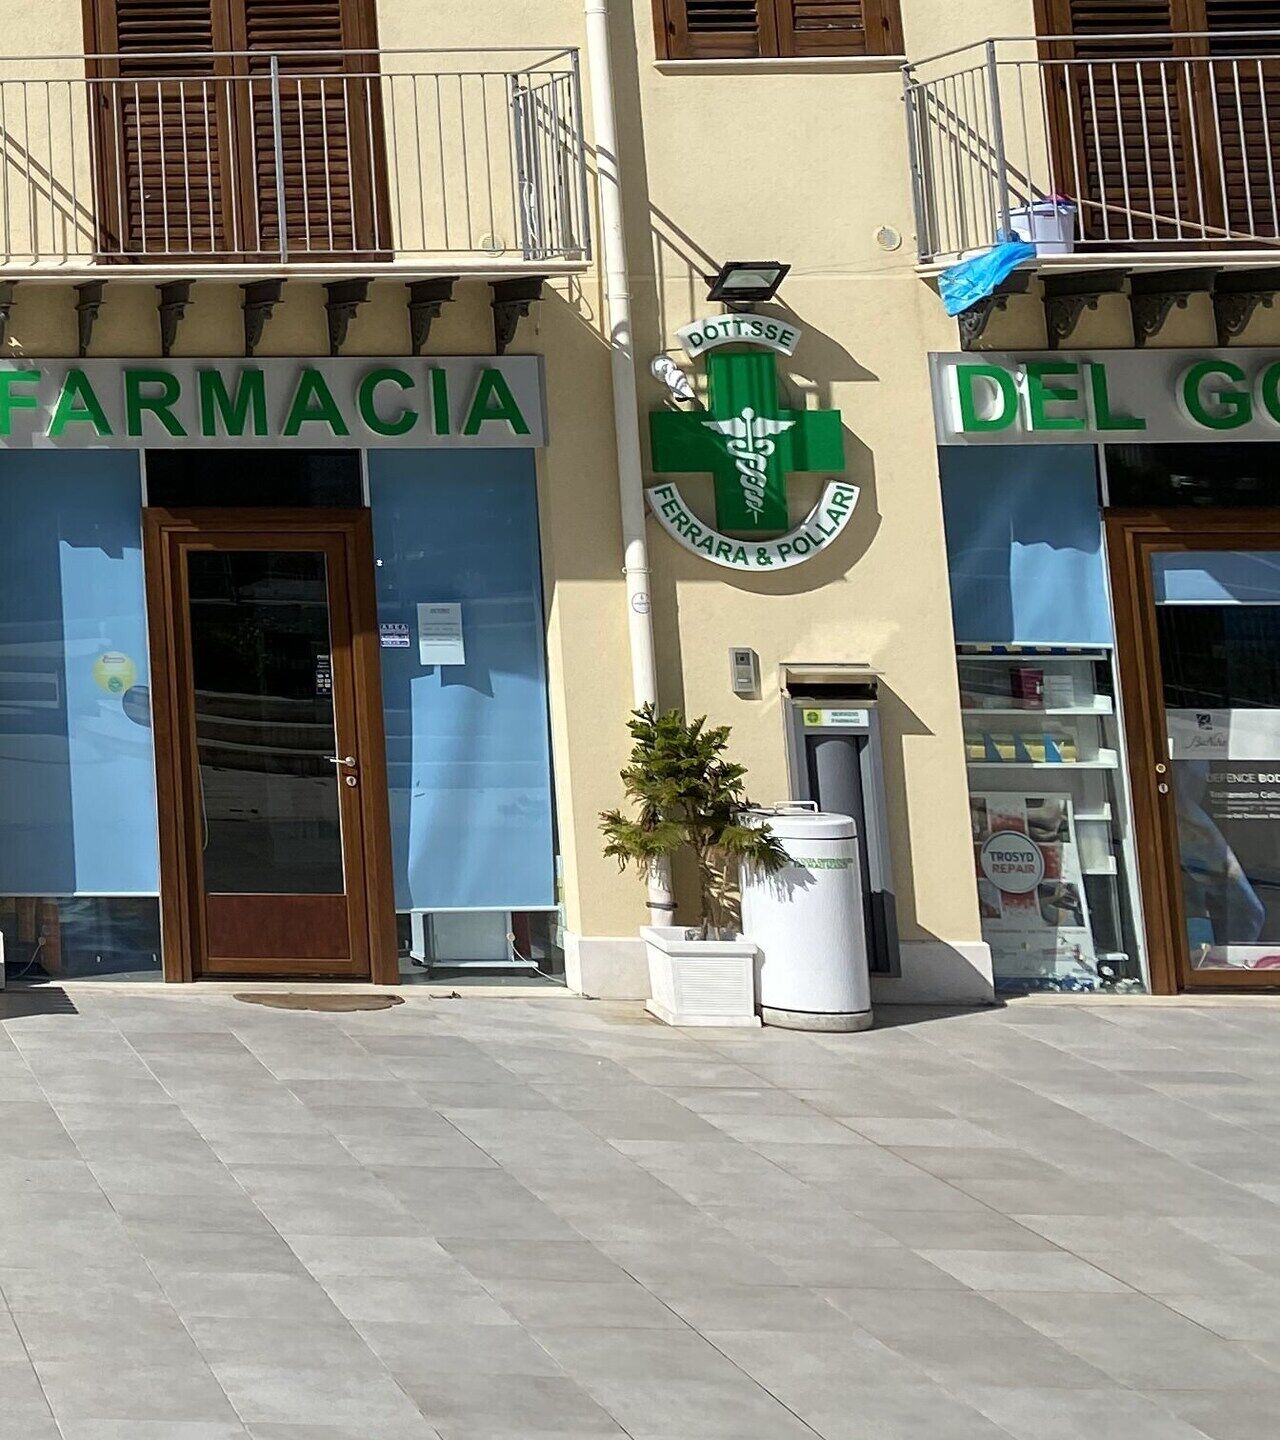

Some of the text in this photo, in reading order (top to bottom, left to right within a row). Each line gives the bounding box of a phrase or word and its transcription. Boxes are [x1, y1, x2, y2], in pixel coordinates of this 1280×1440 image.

[687, 319, 795, 348] DOTT.SSE
[947, 358, 1280, 433] DEL G
[653, 486, 856, 566] FERRARA & POLLARI
[989, 851, 1034, 862] TROSYD
[991, 863, 1036, 874] REPAIR
